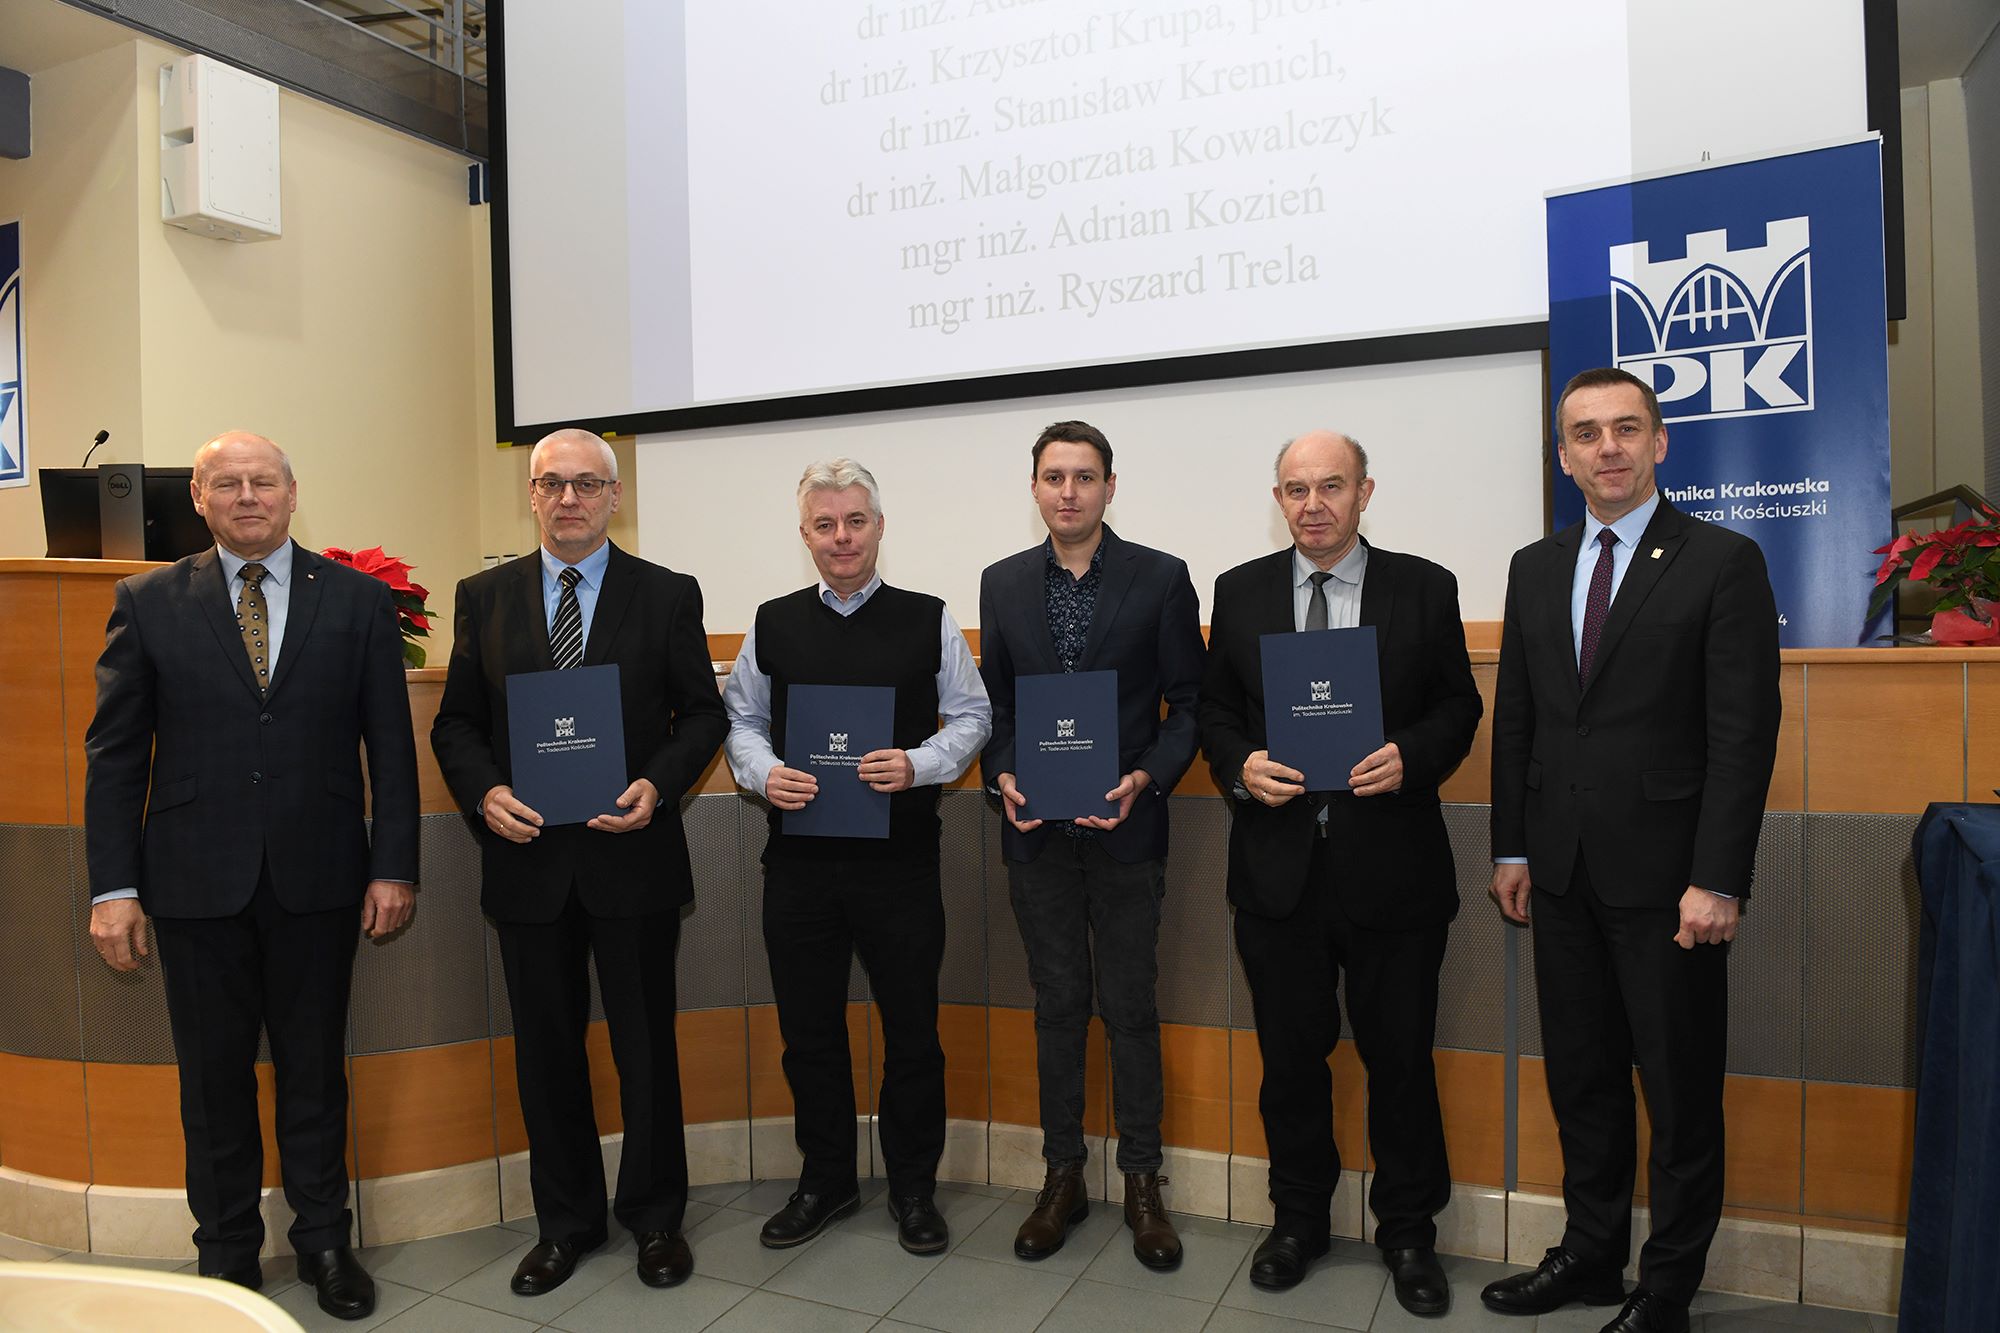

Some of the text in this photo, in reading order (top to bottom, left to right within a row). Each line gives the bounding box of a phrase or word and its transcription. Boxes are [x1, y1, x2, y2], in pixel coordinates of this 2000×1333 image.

[820, 69, 851, 106] dr
[861, 59, 917, 99] inż.
[929, 15, 1101, 85] Krzysztof
[1108, 2, 1236, 50] Krupa,
[857, 3, 888, 40] dr
[879, 38, 1347, 153] dr inż. Stanisław Krenich,
[846, 96, 1396, 218] dr inż. Małgorzata Kowalczyk
[900, 172, 1326, 275] mgr inż. Adrian Kozień
[908, 243, 1321, 335] mgr inż. Ryszard Trela
[1720, 477, 1830, 498] Krakowska
[1730, 499, 1827, 520] Kościuszki
